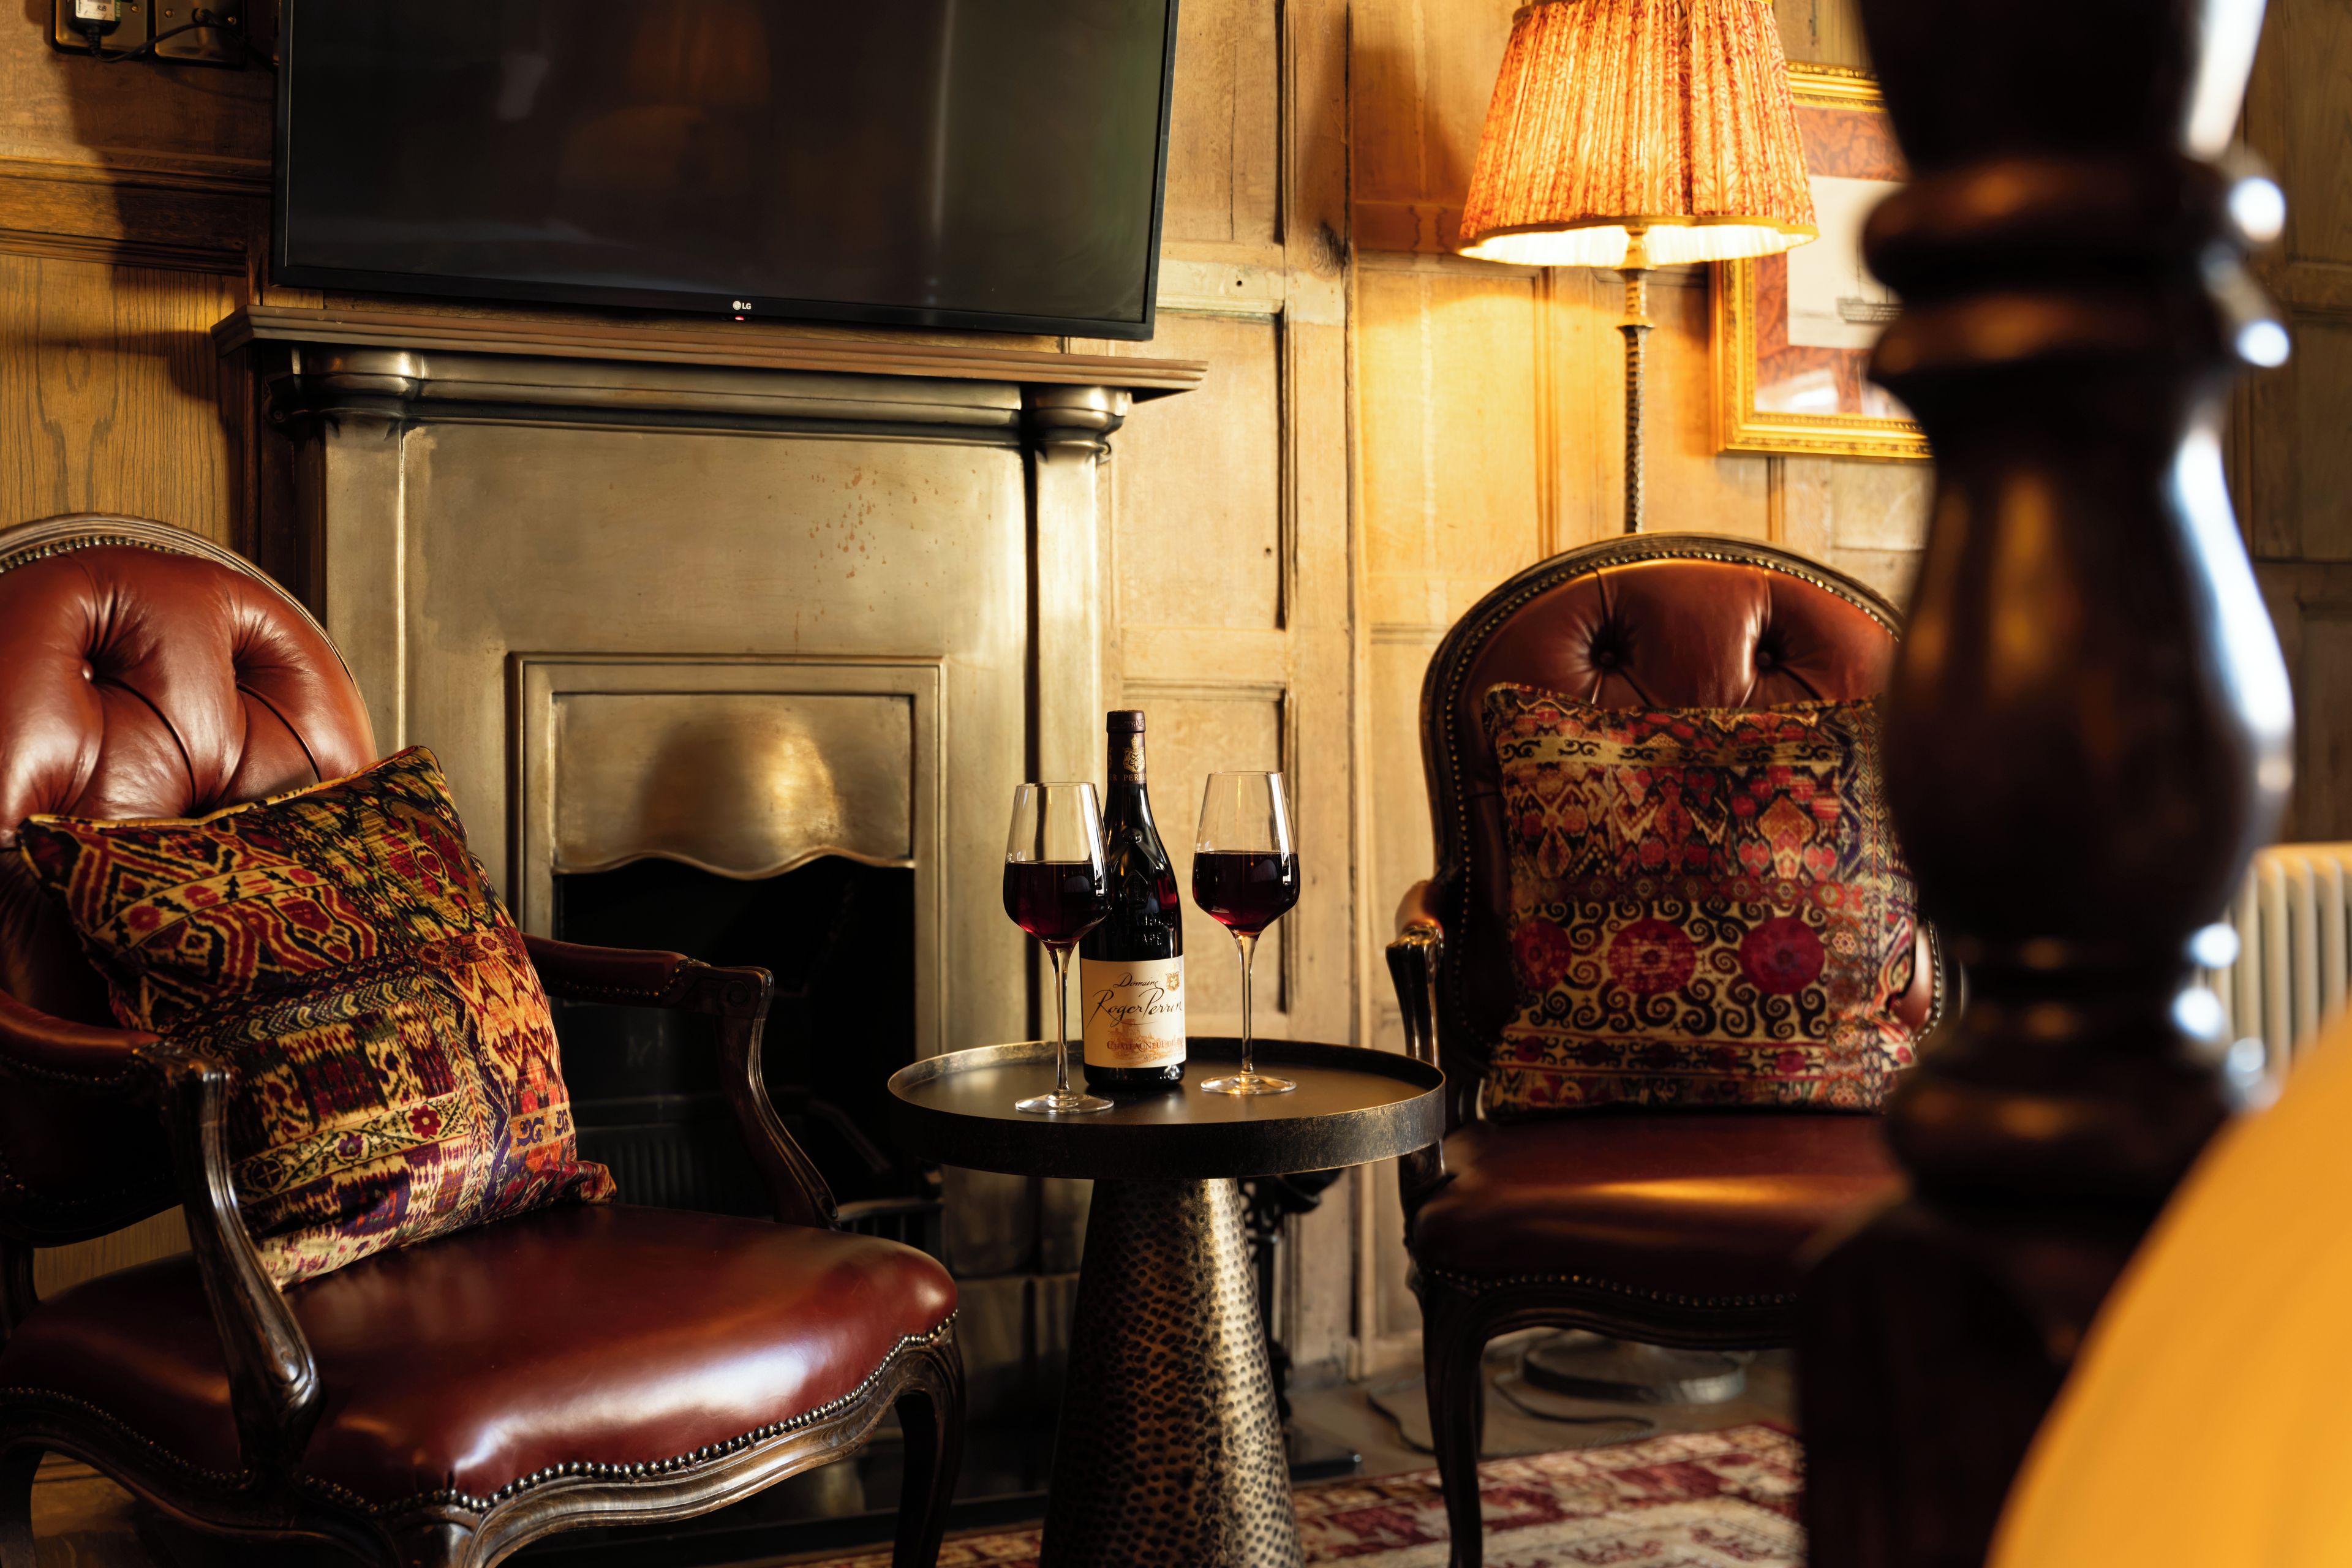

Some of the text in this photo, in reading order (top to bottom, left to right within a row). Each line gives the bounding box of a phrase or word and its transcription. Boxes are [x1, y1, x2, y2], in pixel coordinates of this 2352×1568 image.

[1113, 972, 1159, 988] Domaine
[1087, 987, 1183, 1028] Roger Perrin
